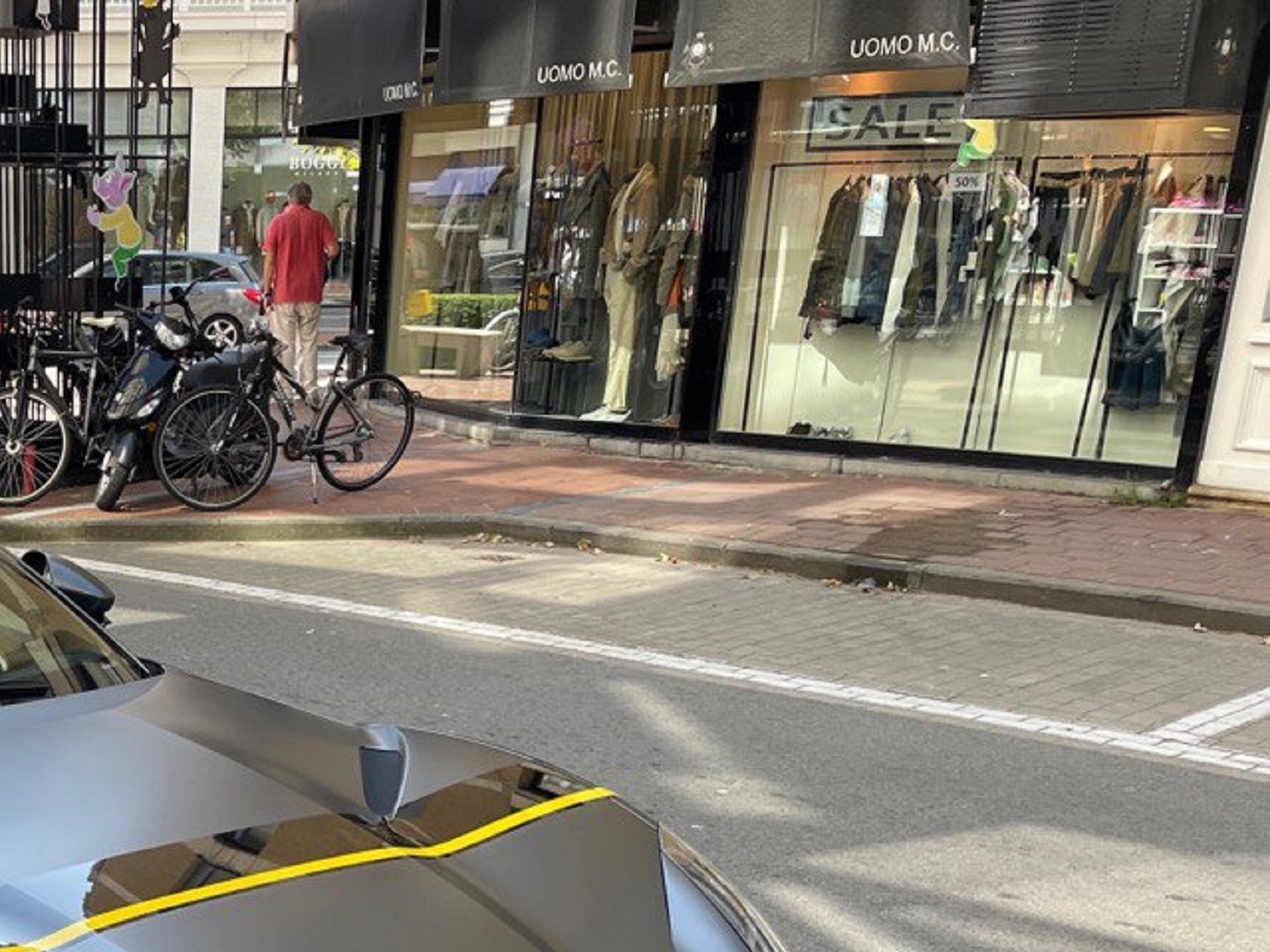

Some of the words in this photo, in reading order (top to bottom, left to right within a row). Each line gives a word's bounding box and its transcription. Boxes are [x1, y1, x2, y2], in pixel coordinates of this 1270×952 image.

[850, 34, 913, 58] UOMO
[918, 31, 960, 53] M.C.
[537, 62, 585, 84] UOMO
[589, 59, 622, 79] M.C.
[826, 102, 955, 140] SALE
[955, 176, 979, 188] 50%
